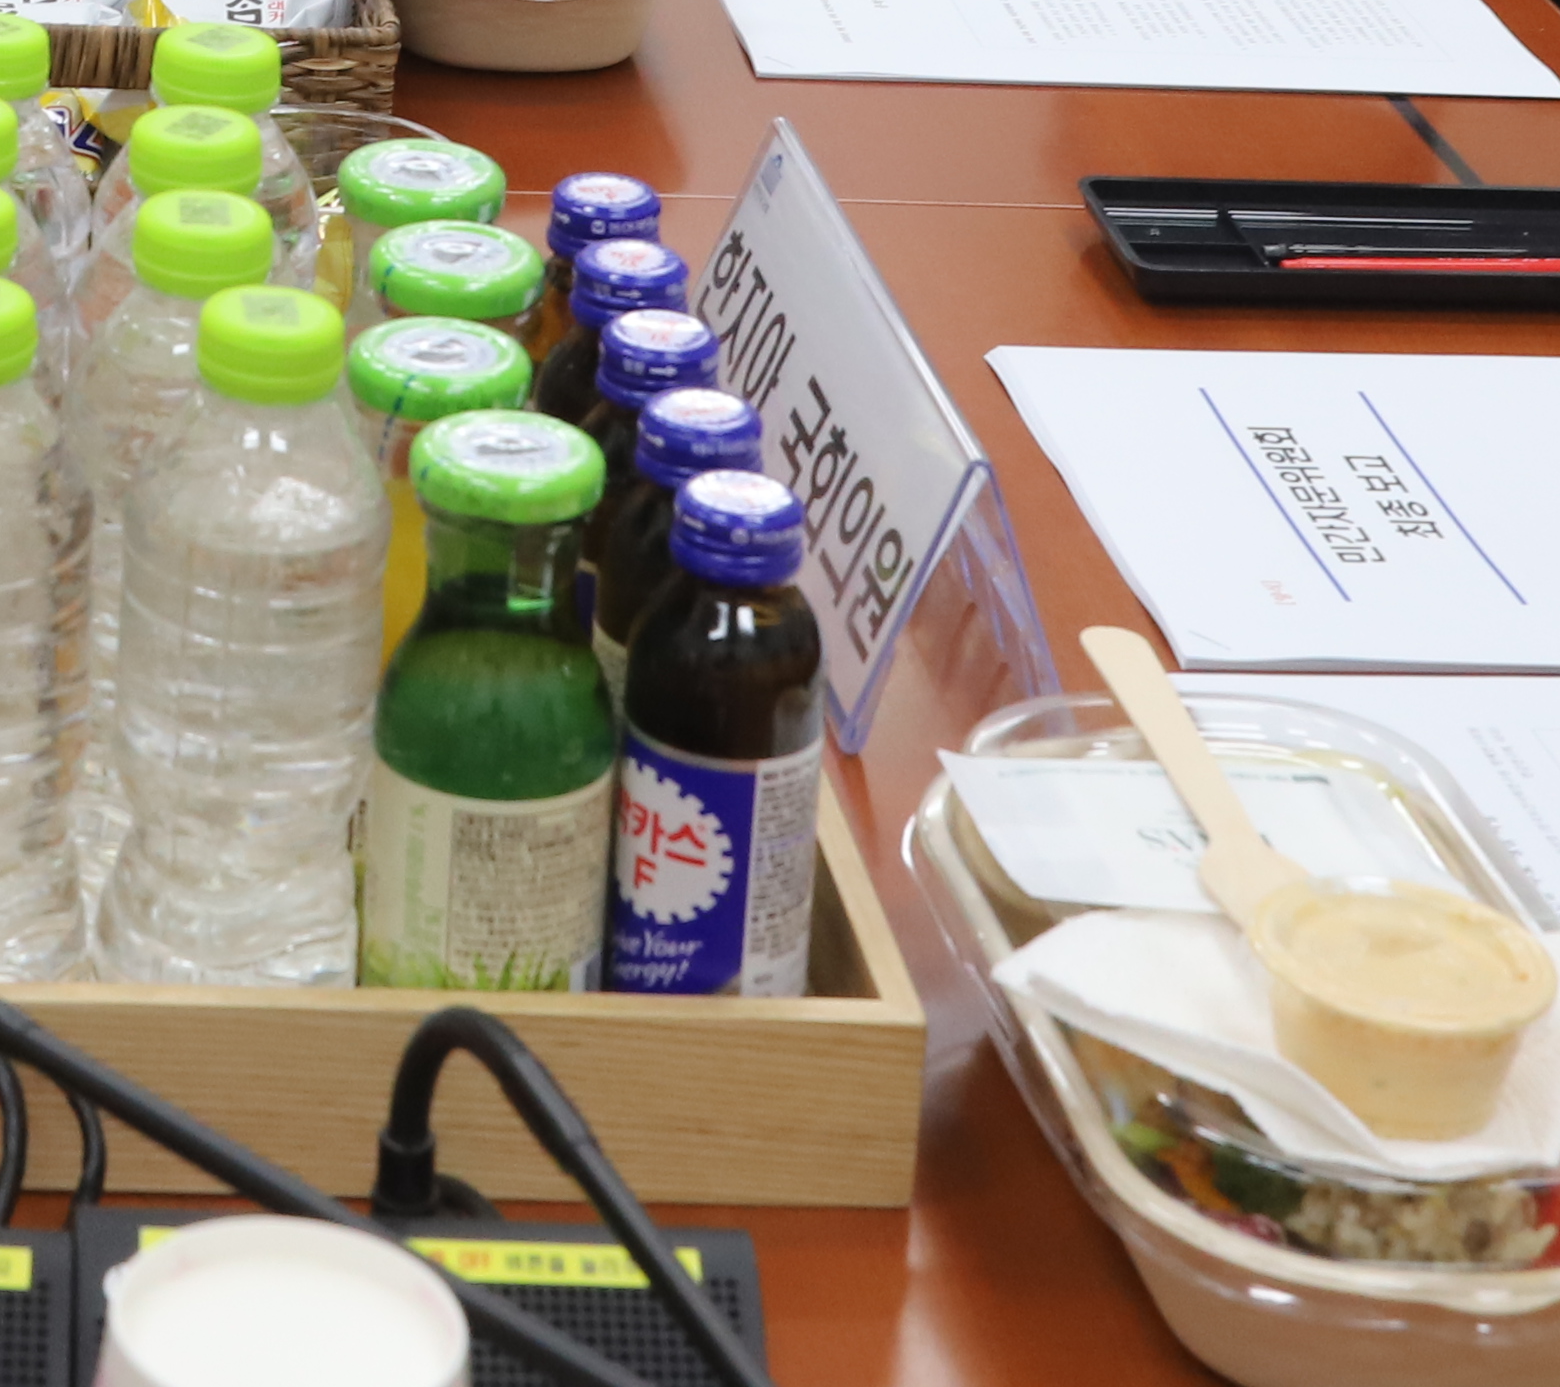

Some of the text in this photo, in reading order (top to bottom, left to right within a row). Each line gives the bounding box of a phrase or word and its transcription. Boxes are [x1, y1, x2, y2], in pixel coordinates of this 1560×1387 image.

[695, 229, 797, 413] 한지아
[780, 373, 914, 663] 국회의원
[1243, 425, 1390, 564] 민간자문위원회
[1340, 453, 1449, 538] 최종 보고
[633, 856, 657, 890] F
